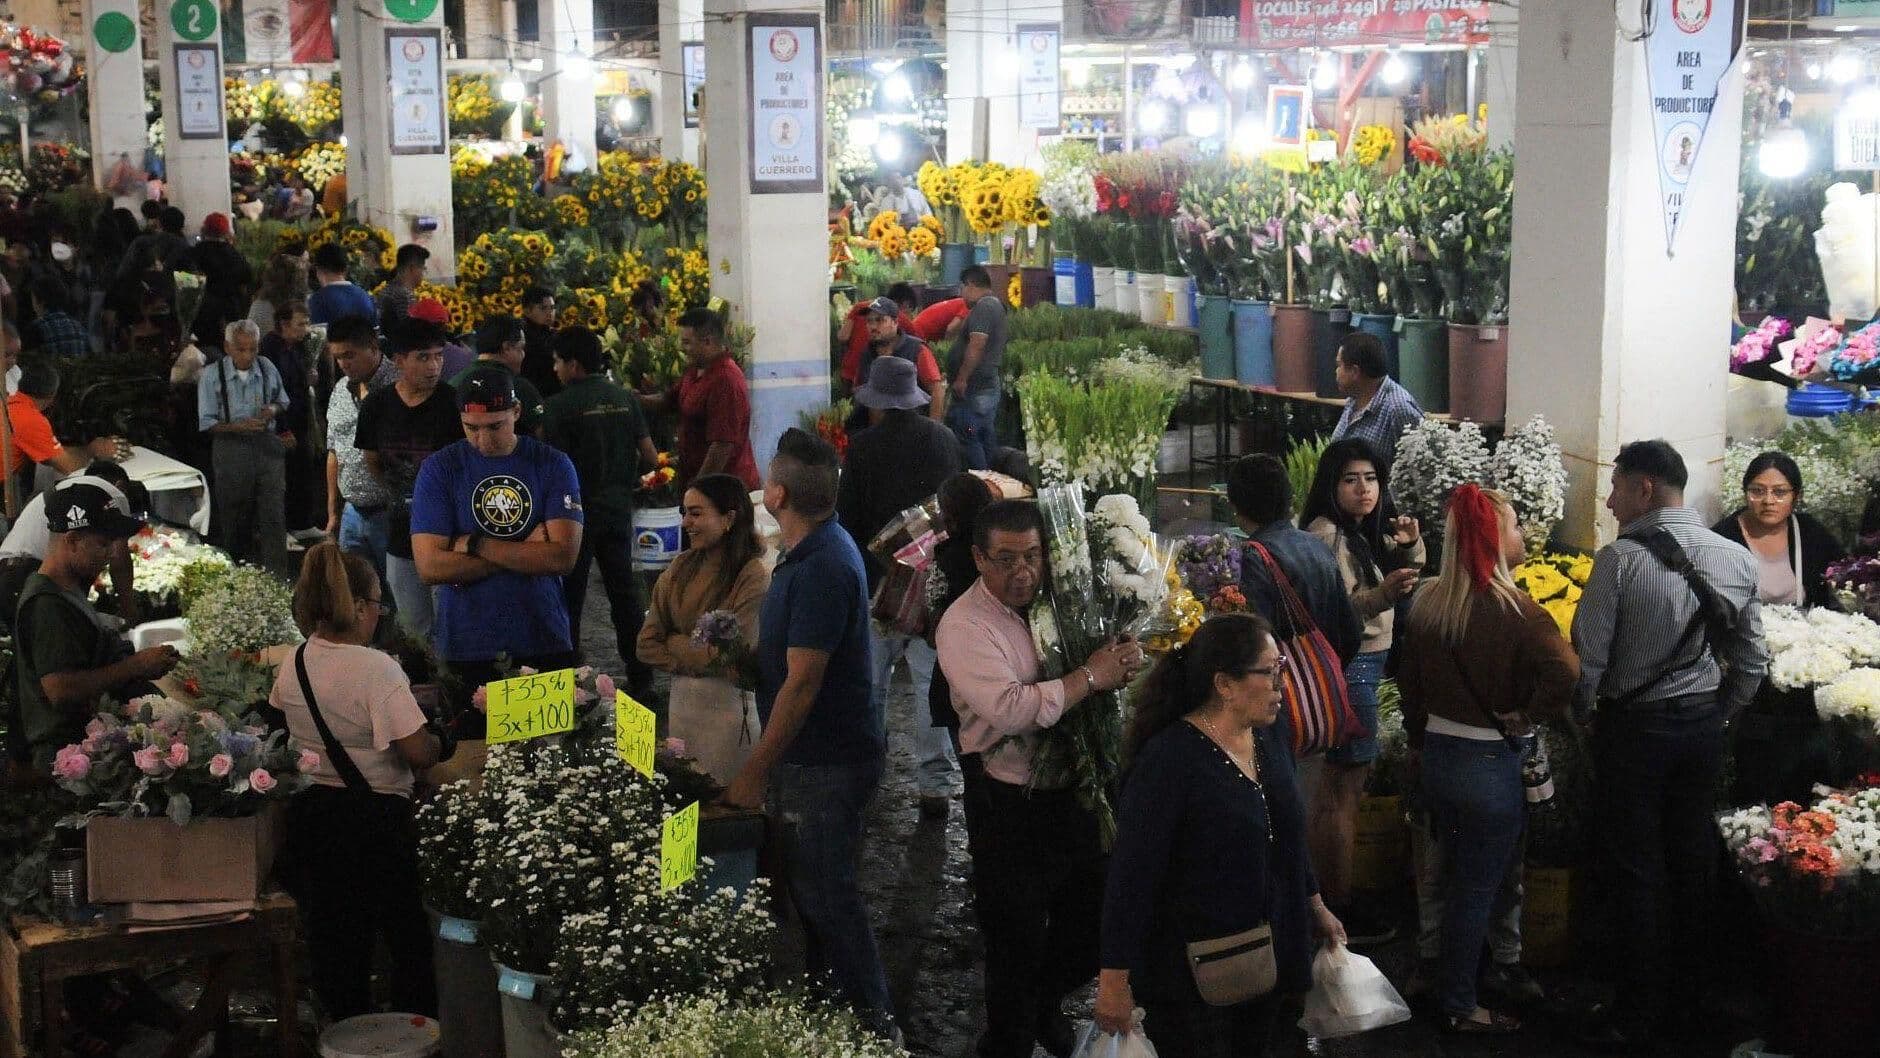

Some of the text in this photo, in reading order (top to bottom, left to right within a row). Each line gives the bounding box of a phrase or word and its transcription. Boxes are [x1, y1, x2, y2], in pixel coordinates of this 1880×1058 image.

[1253, 1, 1312, 16] LOCALES
[188, 4, 201, 33] 2
[1677, 51, 1702, 67] AREA
[1682, 74, 1694, 90] DE
[771, 154, 800, 164] VILLA
[758, 165, 813, 175] GUERRERO
[479, 479, 523, 493] UTAH
